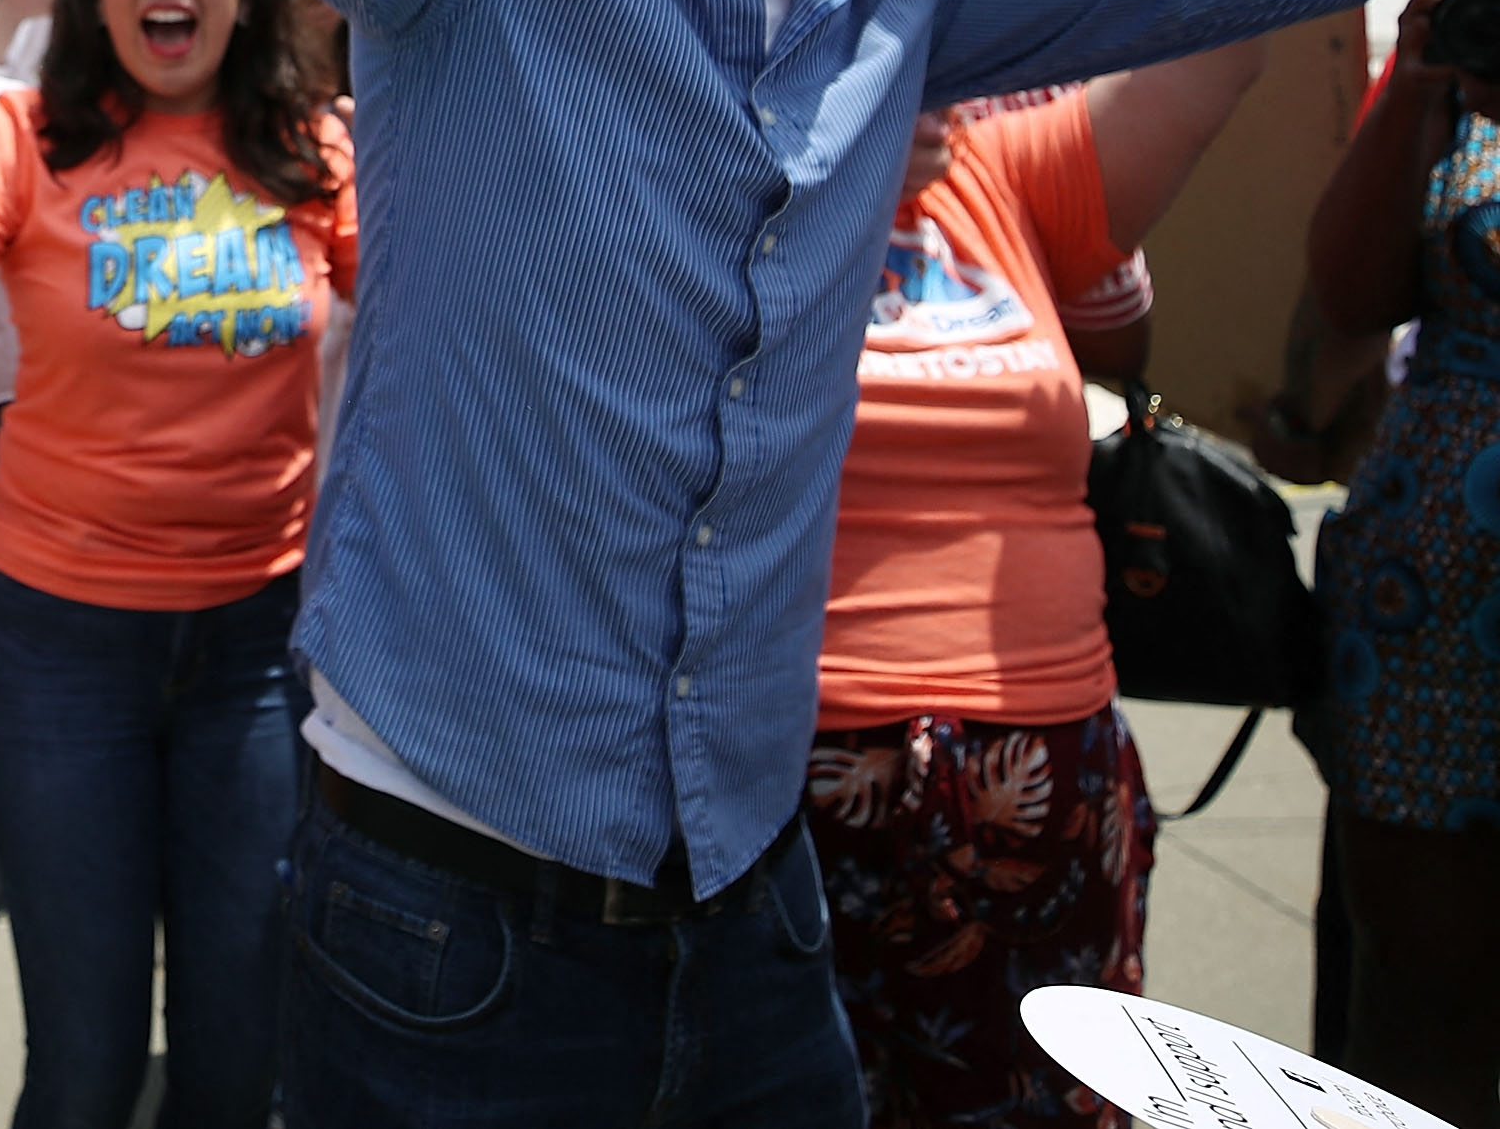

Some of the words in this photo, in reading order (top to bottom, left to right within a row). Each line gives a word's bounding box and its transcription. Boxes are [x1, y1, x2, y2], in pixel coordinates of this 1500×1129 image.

[79, 183, 195, 234] CLEAN
[87, 223, 305, 310] DREAM
[1139, 1016, 1228, 1096] support
